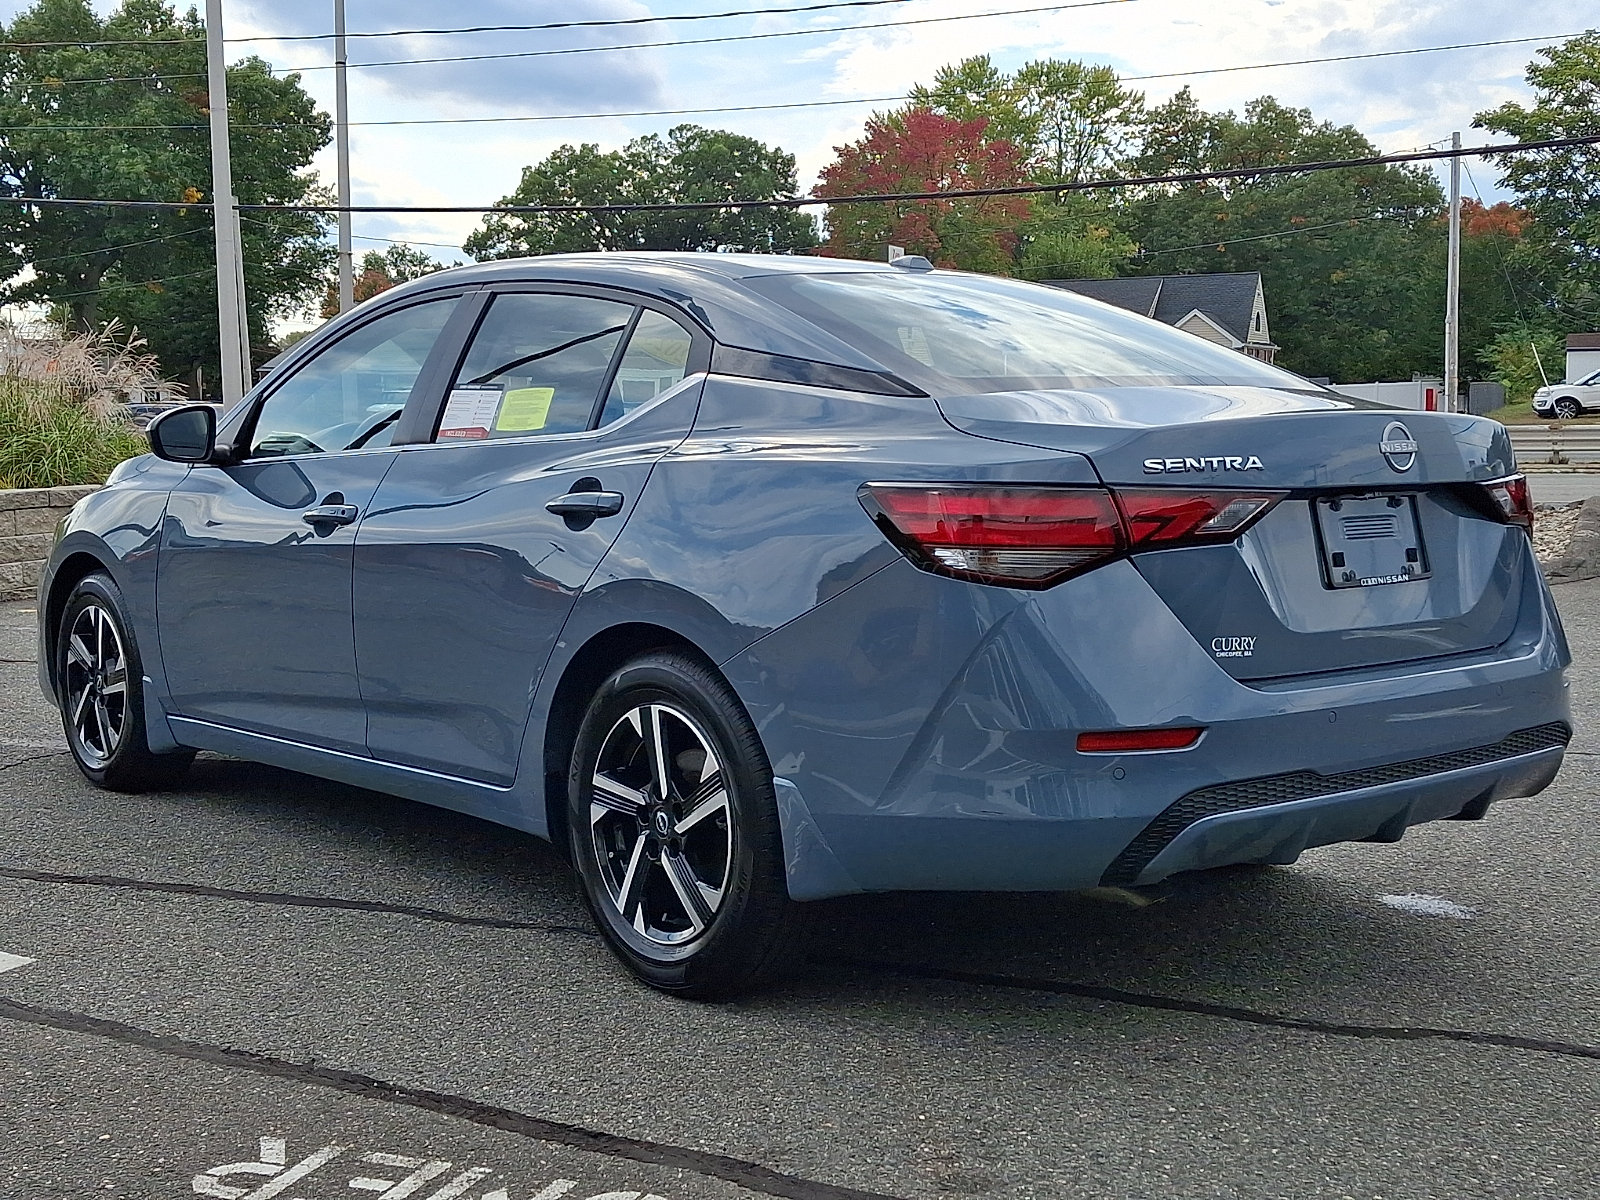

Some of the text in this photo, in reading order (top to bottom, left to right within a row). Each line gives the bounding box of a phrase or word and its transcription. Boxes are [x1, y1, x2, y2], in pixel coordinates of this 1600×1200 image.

[1381, 442, 1418, 451] NISSAN
[1142, 455, 1264, 474] SENTRA
[1377, 574, 1409, 585] NISSAN
[1211, 636, 1257, 651] CURRY
